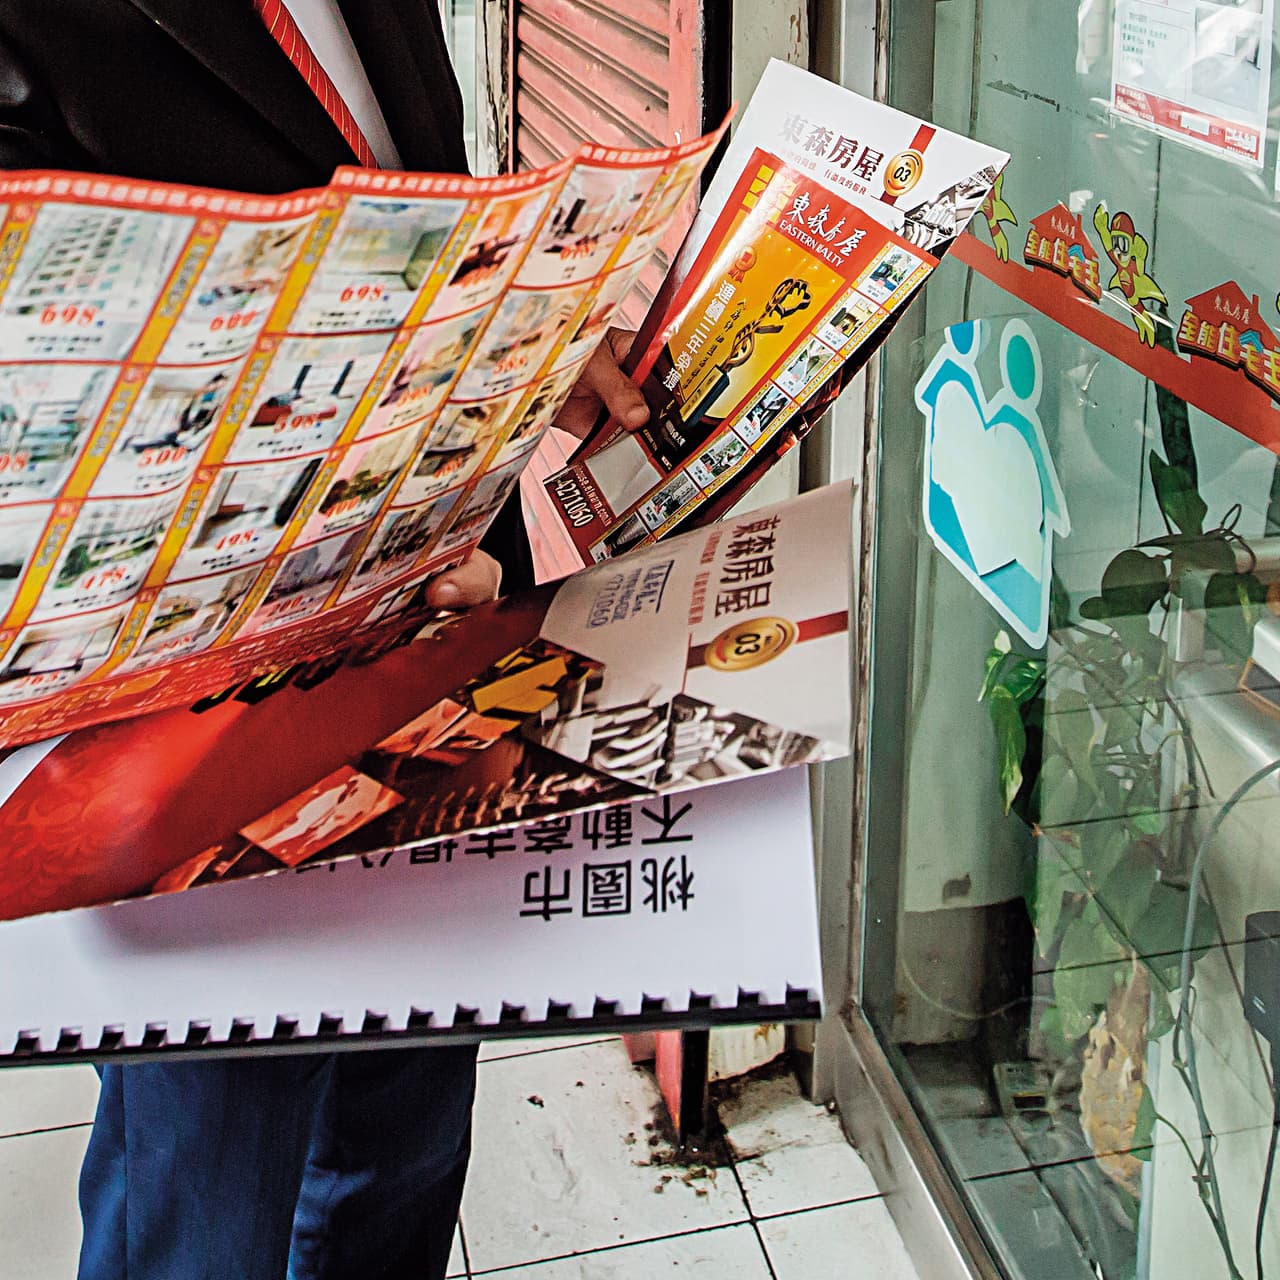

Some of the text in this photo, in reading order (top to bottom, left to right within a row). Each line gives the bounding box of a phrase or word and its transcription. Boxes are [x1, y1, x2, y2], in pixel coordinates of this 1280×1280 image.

[893, 166, 911, 183] 03
[779, 219, 818, 249] EASTERN
[785, 191, 867, 257] 東森房屋
[715, 515, 782, 617] 東森房屋
[519, 855, 696, 921] 桃園市
